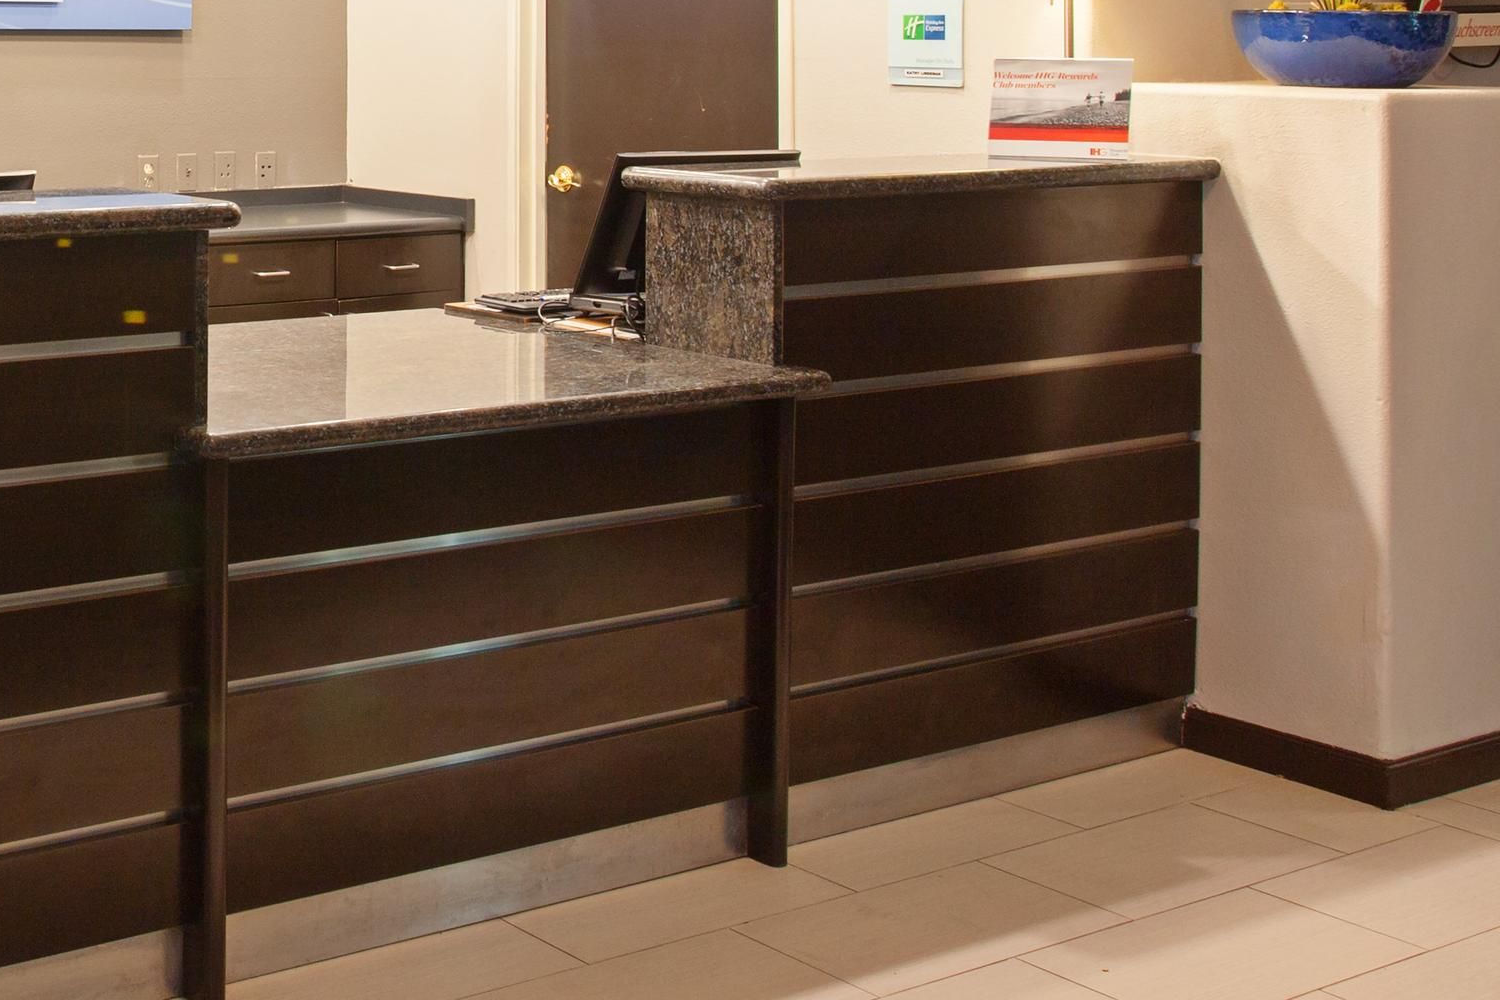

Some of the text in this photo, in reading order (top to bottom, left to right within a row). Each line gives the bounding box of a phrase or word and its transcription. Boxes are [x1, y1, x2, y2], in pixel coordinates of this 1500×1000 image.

[1455, 17, 1500, 37] uchscreen
[994, 71, 1033, 79] Welcome
[1058, 72, 1098, 80] Rewards
[1015, 81, 1056, 89] members
